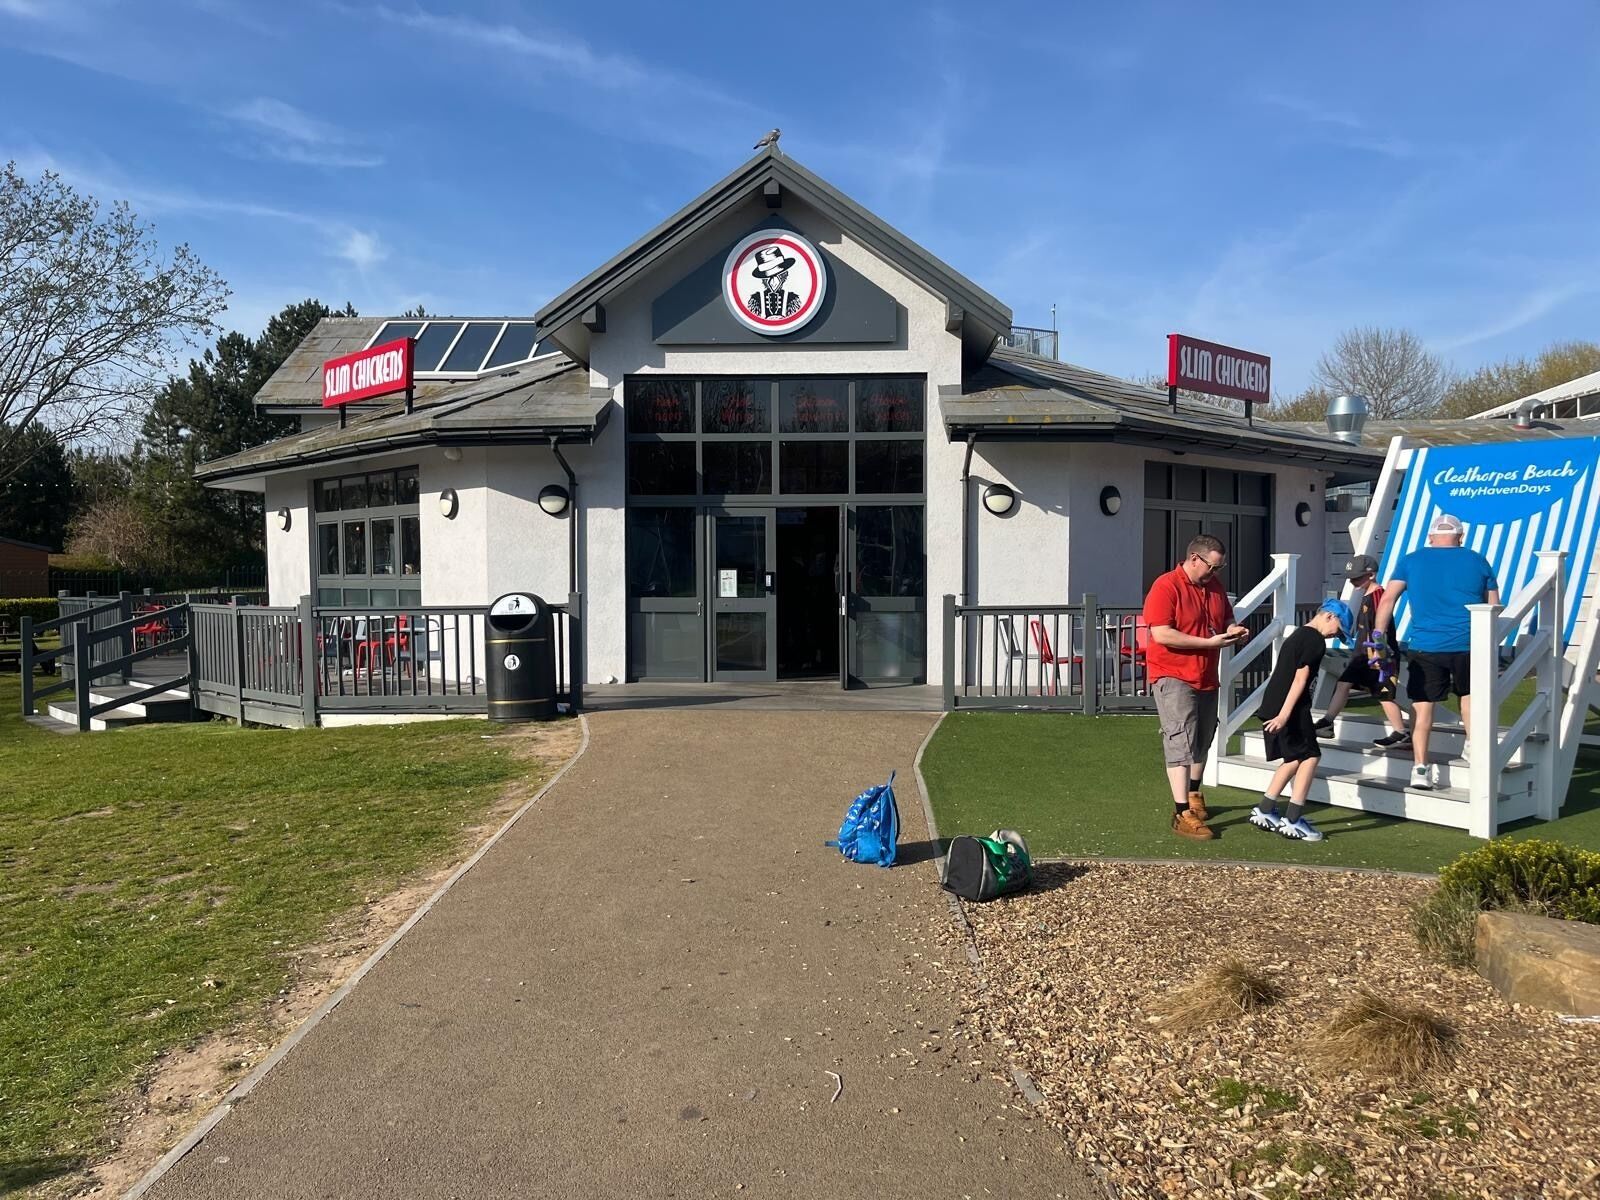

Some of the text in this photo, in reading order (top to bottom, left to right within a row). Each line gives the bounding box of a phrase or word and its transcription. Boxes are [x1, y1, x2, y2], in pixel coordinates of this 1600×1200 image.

[325, 347, 404, 398] SLIM CHICKENS
[1180, 345, 1268, 394] SLIM CHICKENS
[1433, 459, 1579, 487] Cleethorpes Beach
[1450, 484, 1552, 499] #MyHavenDays
